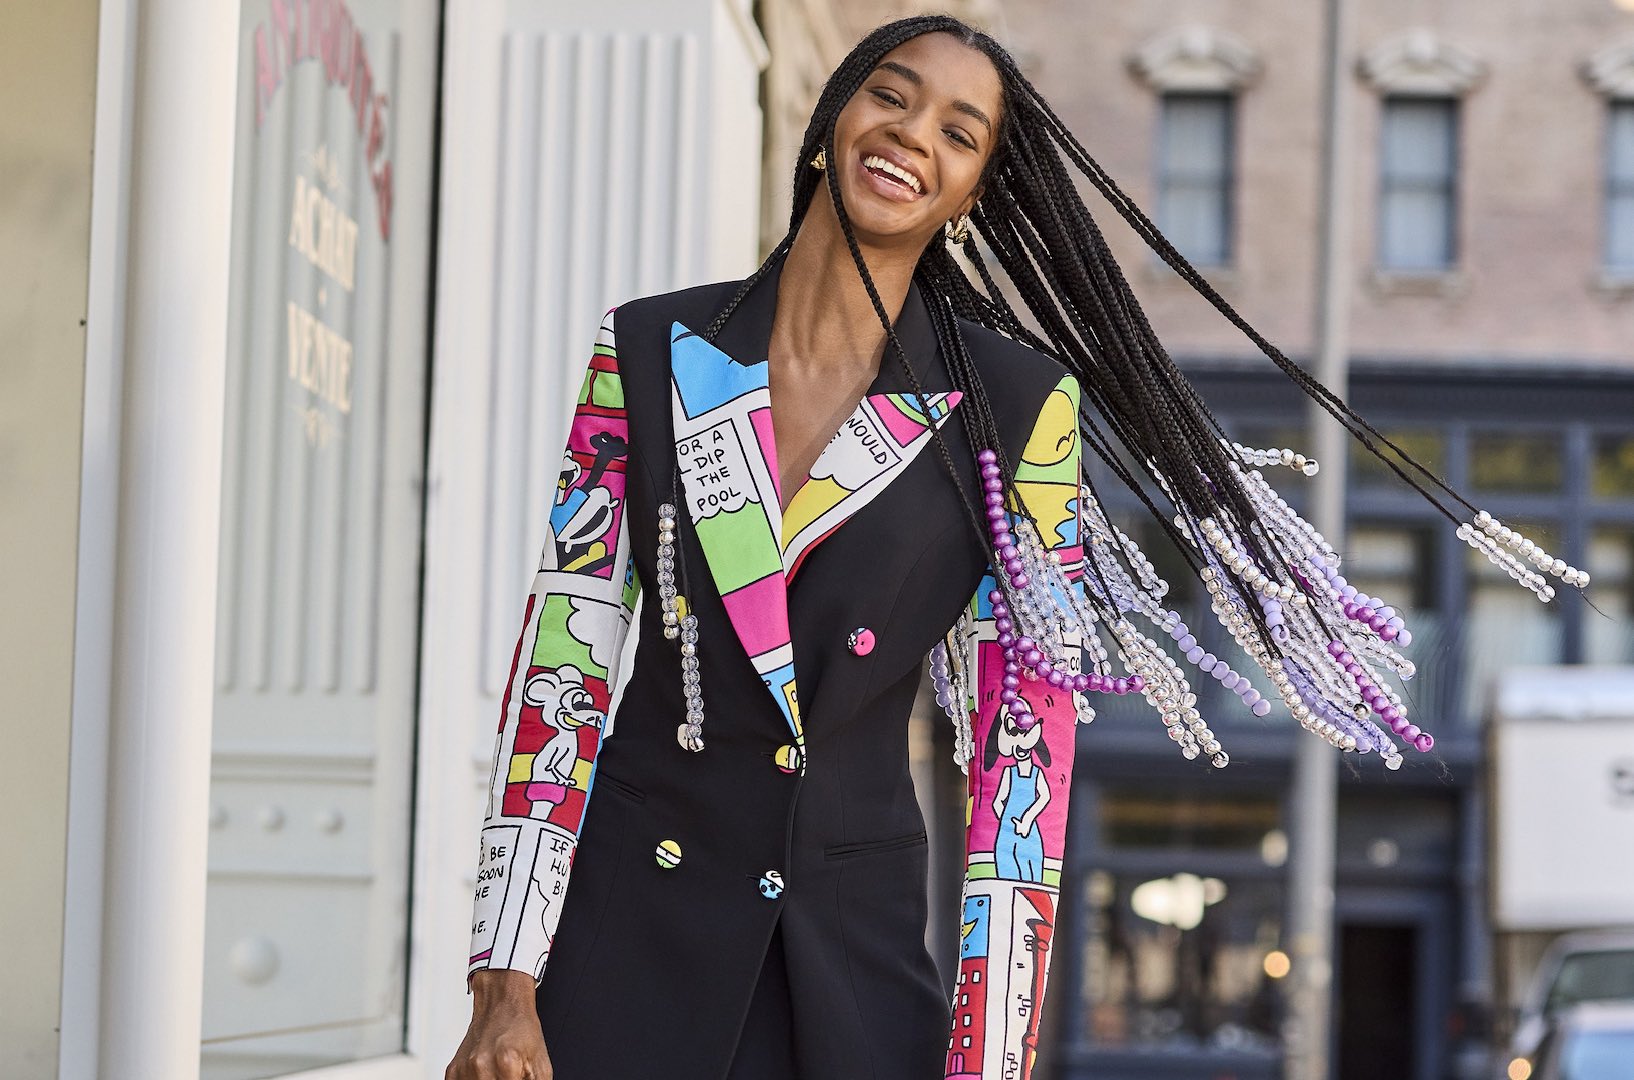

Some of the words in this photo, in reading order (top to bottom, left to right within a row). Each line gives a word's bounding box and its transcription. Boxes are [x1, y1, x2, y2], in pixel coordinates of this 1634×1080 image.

[288, 174, 359, 292] ACHAT
[287, 301, 353, 415] VENTE
[712, 430, 725, 444] A
[693, 448, 725, 470] DIP
[695, 466, 731, 487] THE
[696, 486, 741, 512] POOL
[490, 846, 507, 862] BE
[477, 864, 504, 884] SOON
